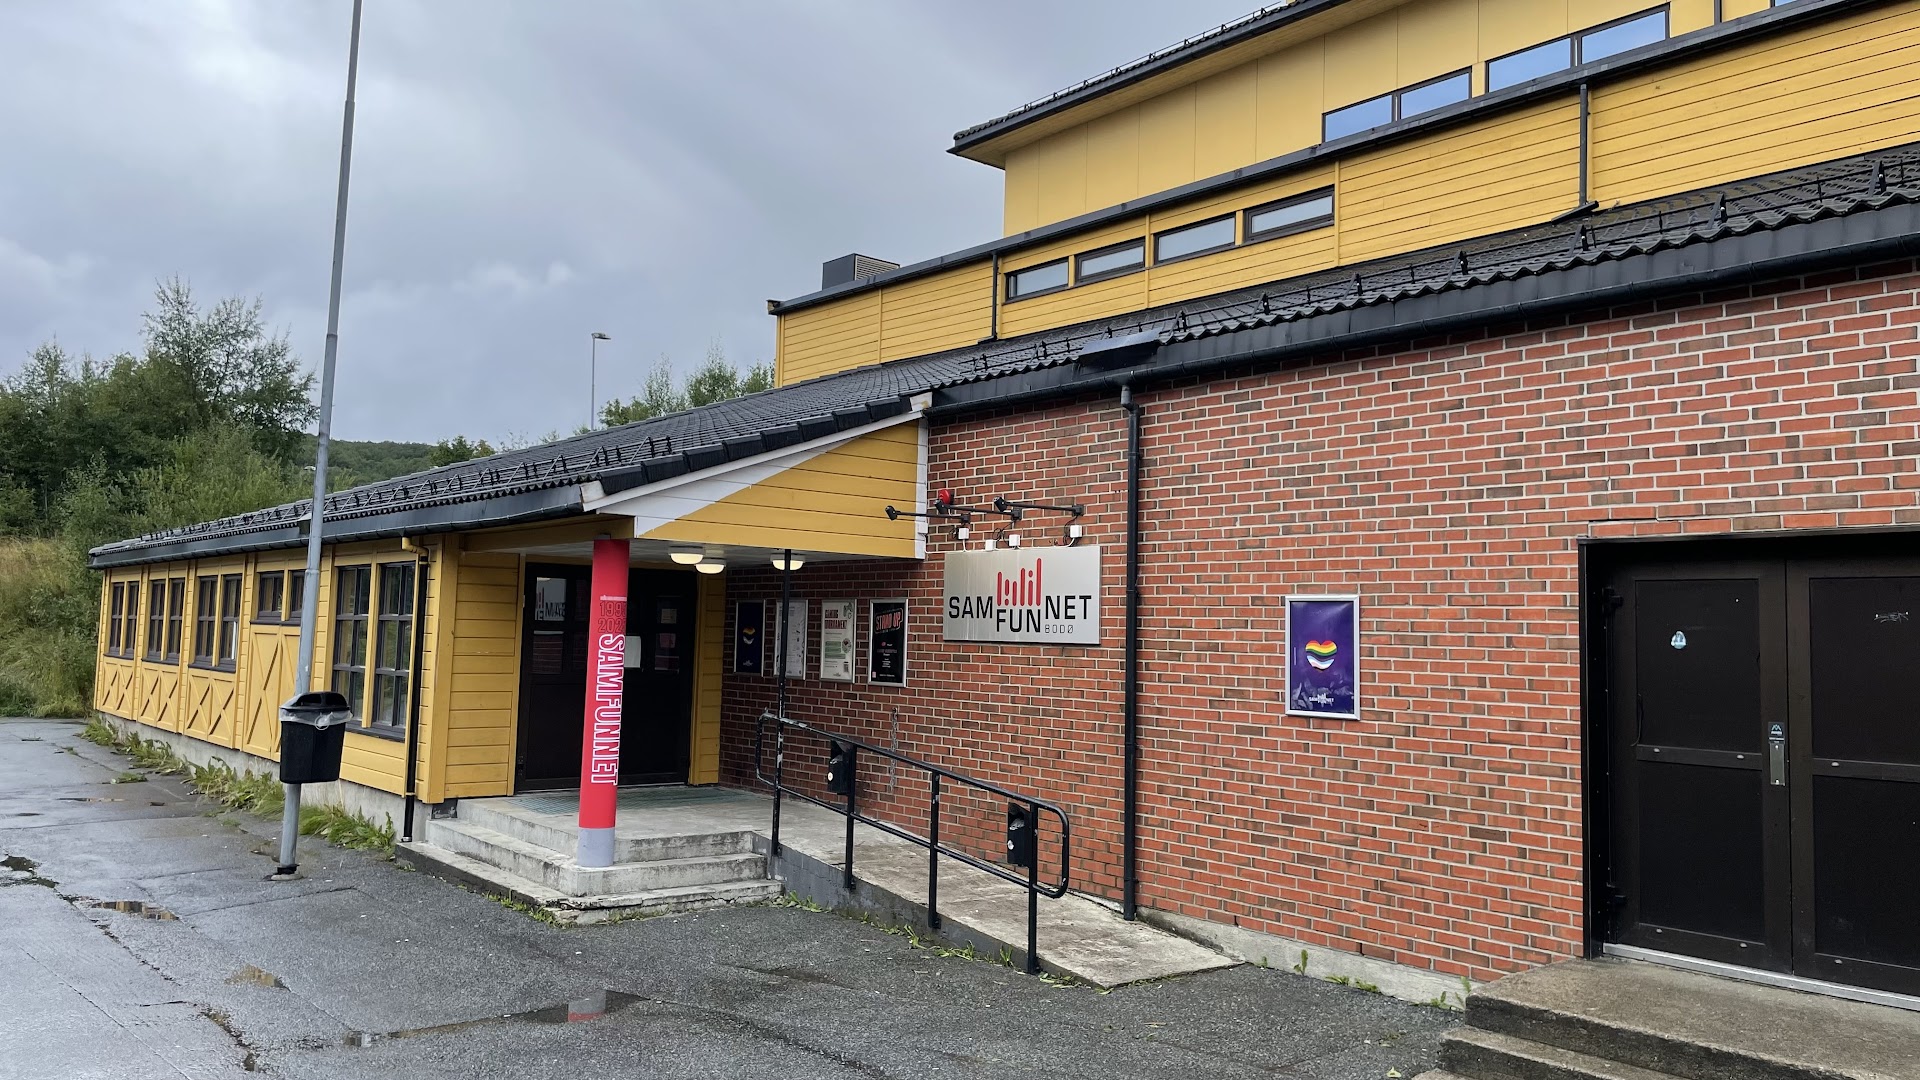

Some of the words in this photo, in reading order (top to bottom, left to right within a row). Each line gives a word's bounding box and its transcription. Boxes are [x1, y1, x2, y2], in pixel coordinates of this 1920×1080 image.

[948, 595, 993, 619] SAM
[996, 608, 1041, 633] FUN
[1045, 595, 1092, 620] NET
[591, 633, 626, 786] SAMFUNNET
